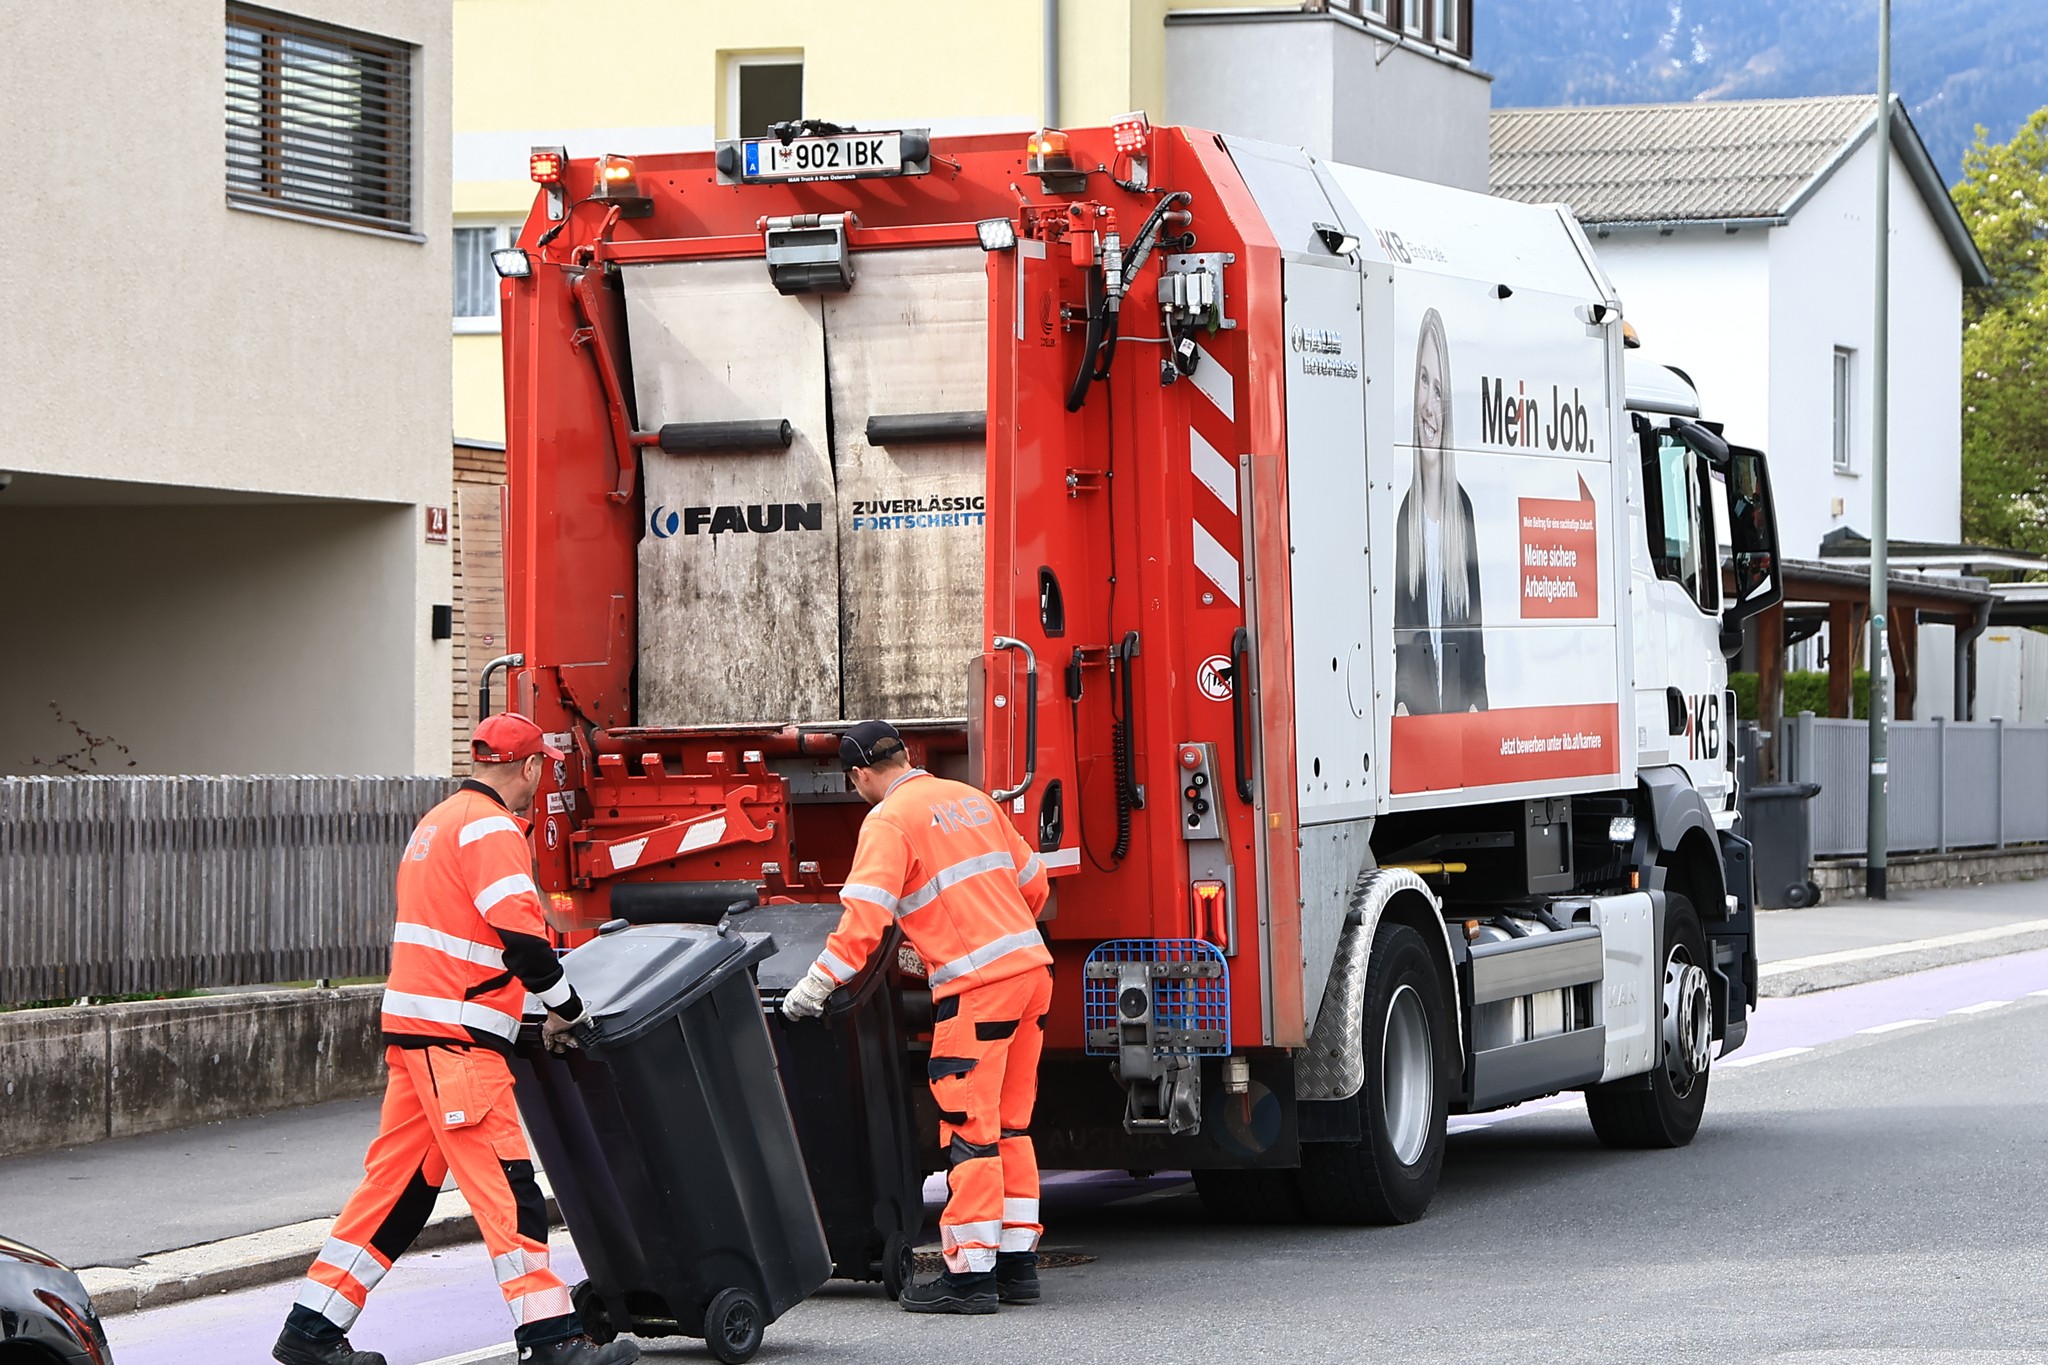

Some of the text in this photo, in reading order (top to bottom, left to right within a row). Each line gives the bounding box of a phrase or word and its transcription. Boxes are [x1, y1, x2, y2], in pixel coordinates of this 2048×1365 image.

[796, 144, 839, 169] 902
[847, 140, 883, 166] IBK
[1481, 375, 1595, 454] Mein Job.
[852, 495, 985, 514] ZUVERLÄSSIG
[684, 502, 822, 536] FAUN
[852, 512, 986, 531] FORTSCHRITT
[1523, 516, 1533, 528] Mein
[1532, 516, 1546, 531] Beitrag
[1552, 518, 1560, 529] eine
[1524, 543, 1577, 567] Meine sichere
[1524, 574, 1578, 604] Arbeitgeberin.
[1500, 737, 1516, 756] Jetzt
[1516, 735, 1546, 754] bewerben
[1546, 734, 1562, 752] unter
